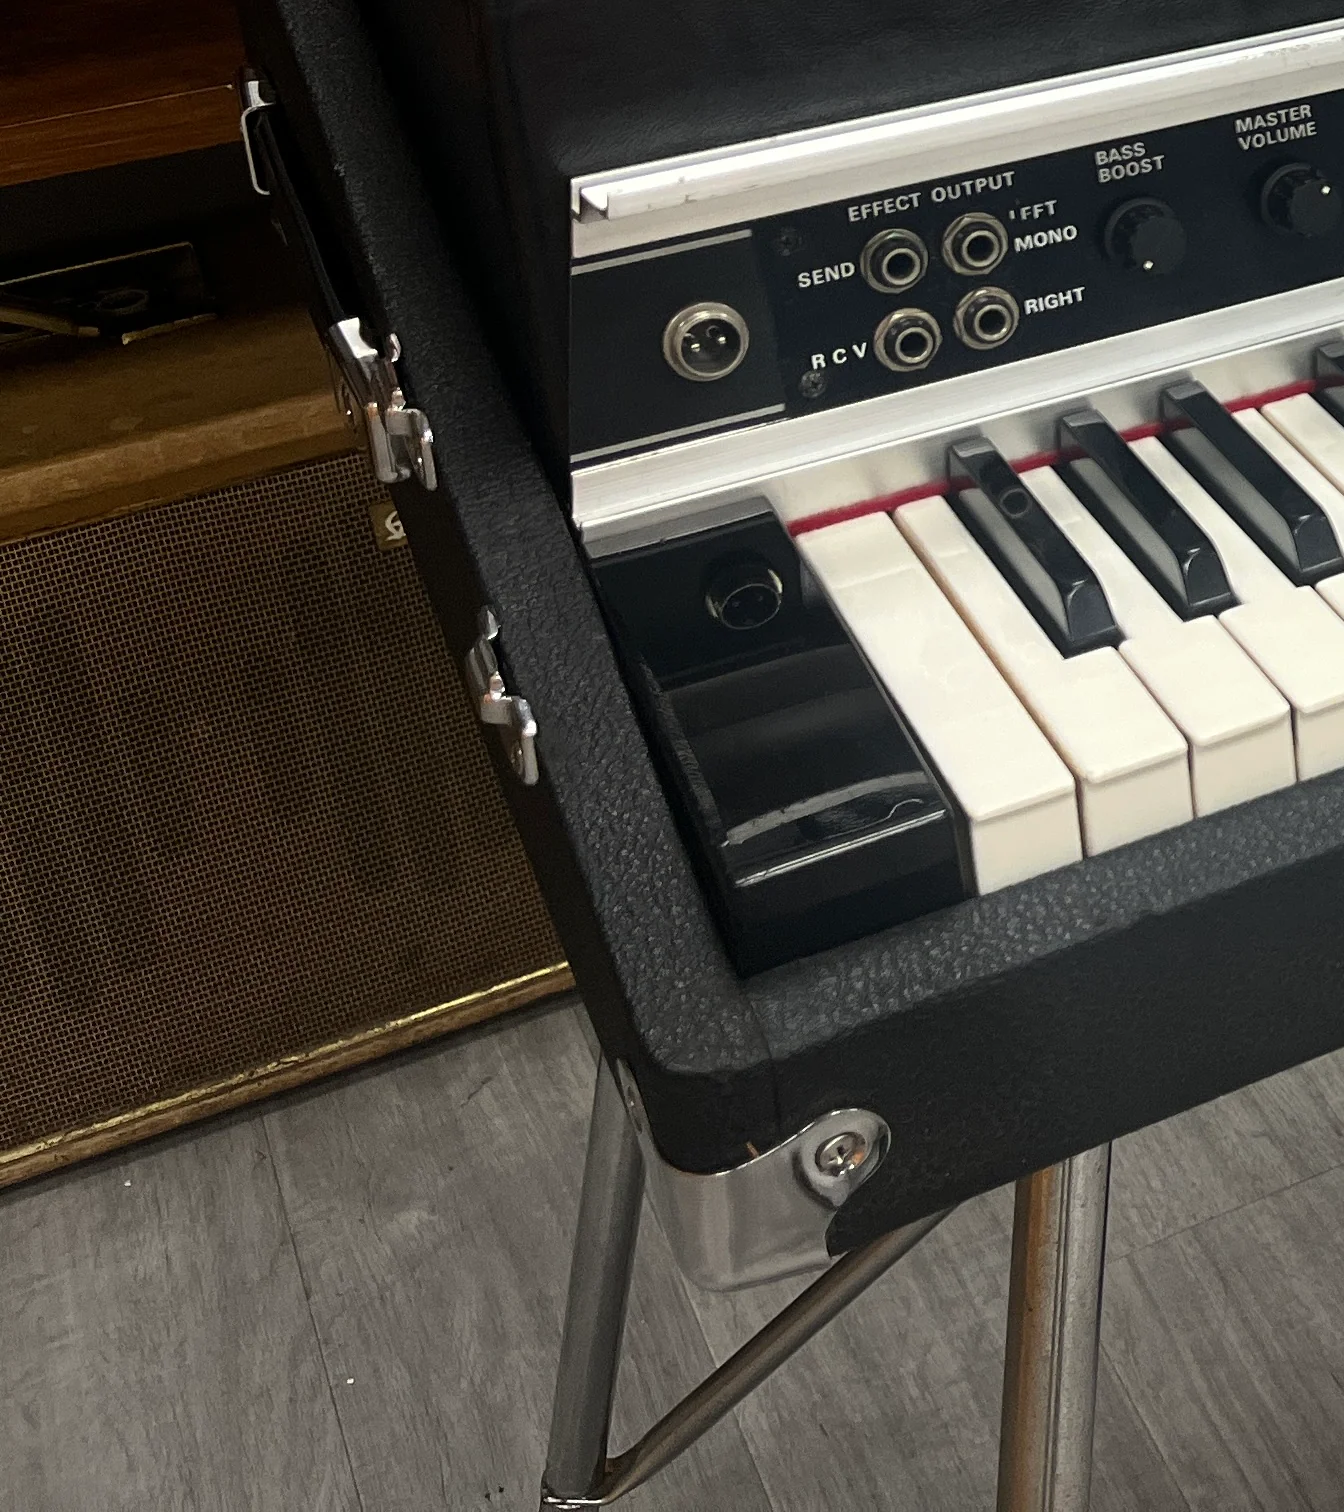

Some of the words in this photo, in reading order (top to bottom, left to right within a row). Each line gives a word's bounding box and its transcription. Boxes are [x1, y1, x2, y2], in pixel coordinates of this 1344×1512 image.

[1235, 104, 1312, 134] MASTER
[1237, 122, 1317, 151] VOLUME
[1095, 142, 1147, 166] BASS
[1098, 155, 1165, 184] BOOST
[847, 192, 921, 223] EFFECT
[931, 171, 1016, 204] OUTPUT
[1014, 225, 1077, 252] MONO
[797, 261, 855, 289] SEND
[1023, 286, 1085, 316] RIGHT
